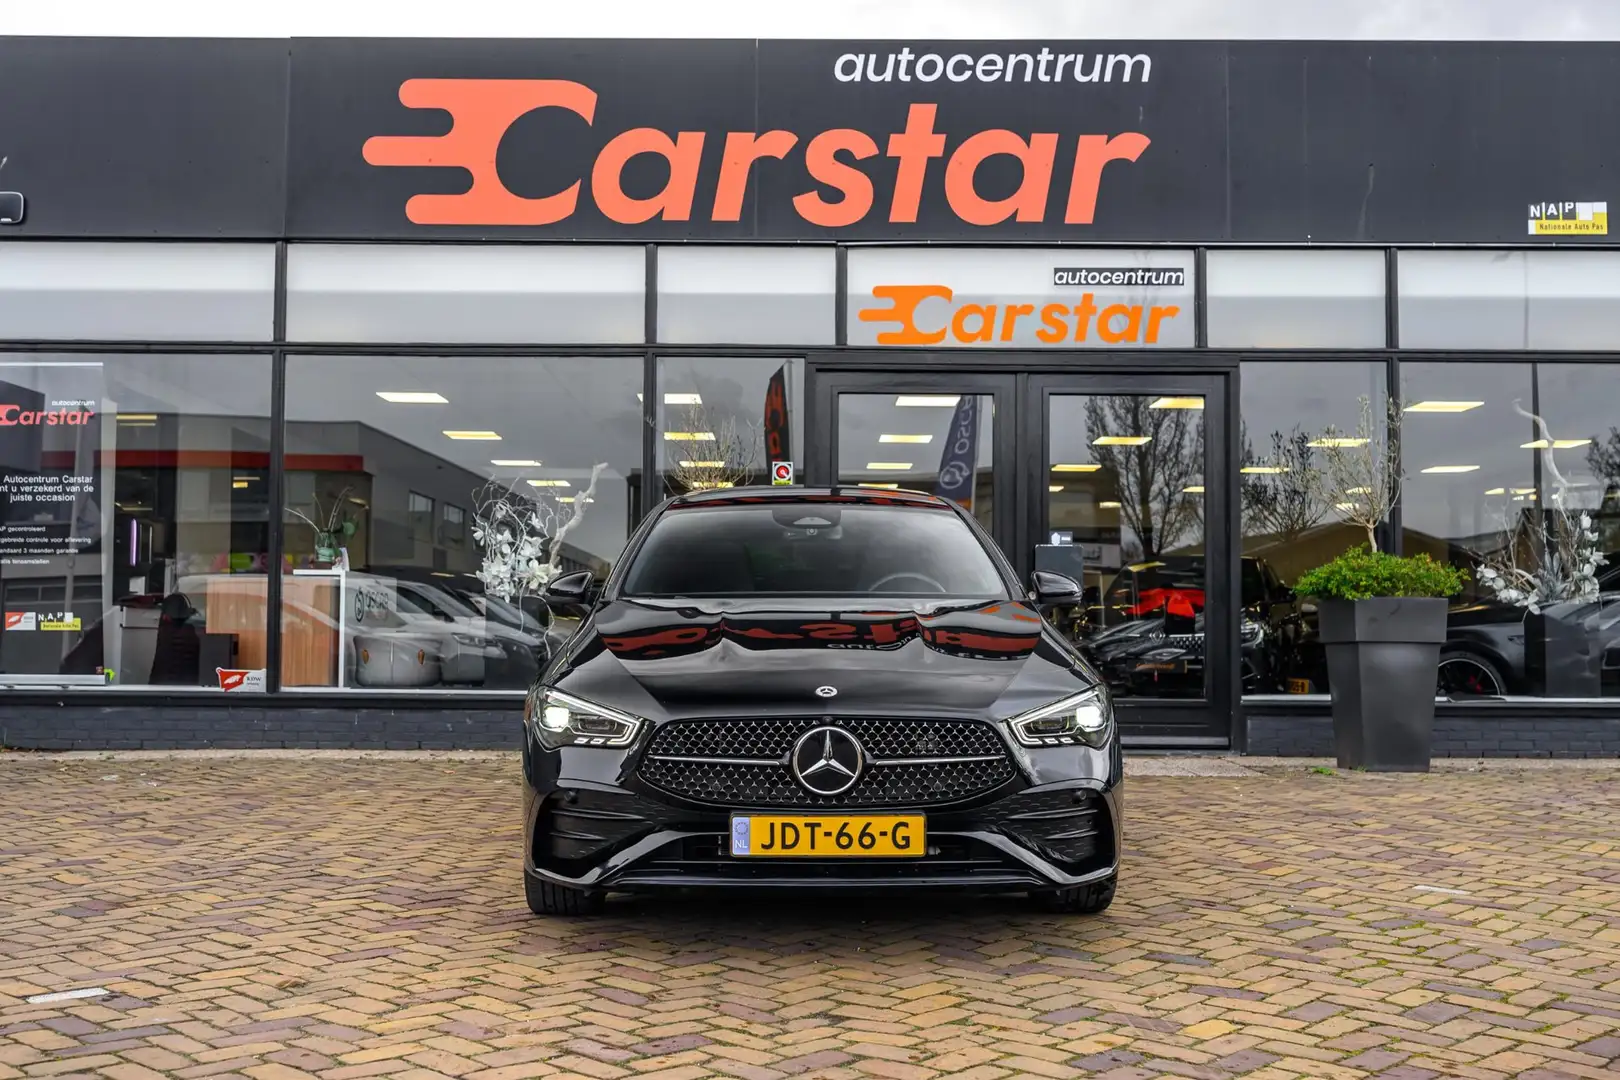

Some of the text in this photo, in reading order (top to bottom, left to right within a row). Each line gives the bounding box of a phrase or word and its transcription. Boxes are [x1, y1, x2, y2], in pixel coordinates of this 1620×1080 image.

[834, 47, 1152, 83] autocentrum
[363, 78, 1150, 227] Carstar
[1592, 223, 1604, 231] Pas
[1054, 268, 1185, 286] autocentrum
[858, 285, 1180, 345] Carstar
[0, 404, 95, 426] Carstar
[3, 475, 94, 483] Autocentrum Carstar
[20, 484, 63, 493] verzekerd
[83, 484, 94, 493] de
[10, 493, 76, 503] juiste occasion
[735, 840, 748, 849] NL
[761, 821, 911, 850] JDT-66-G
